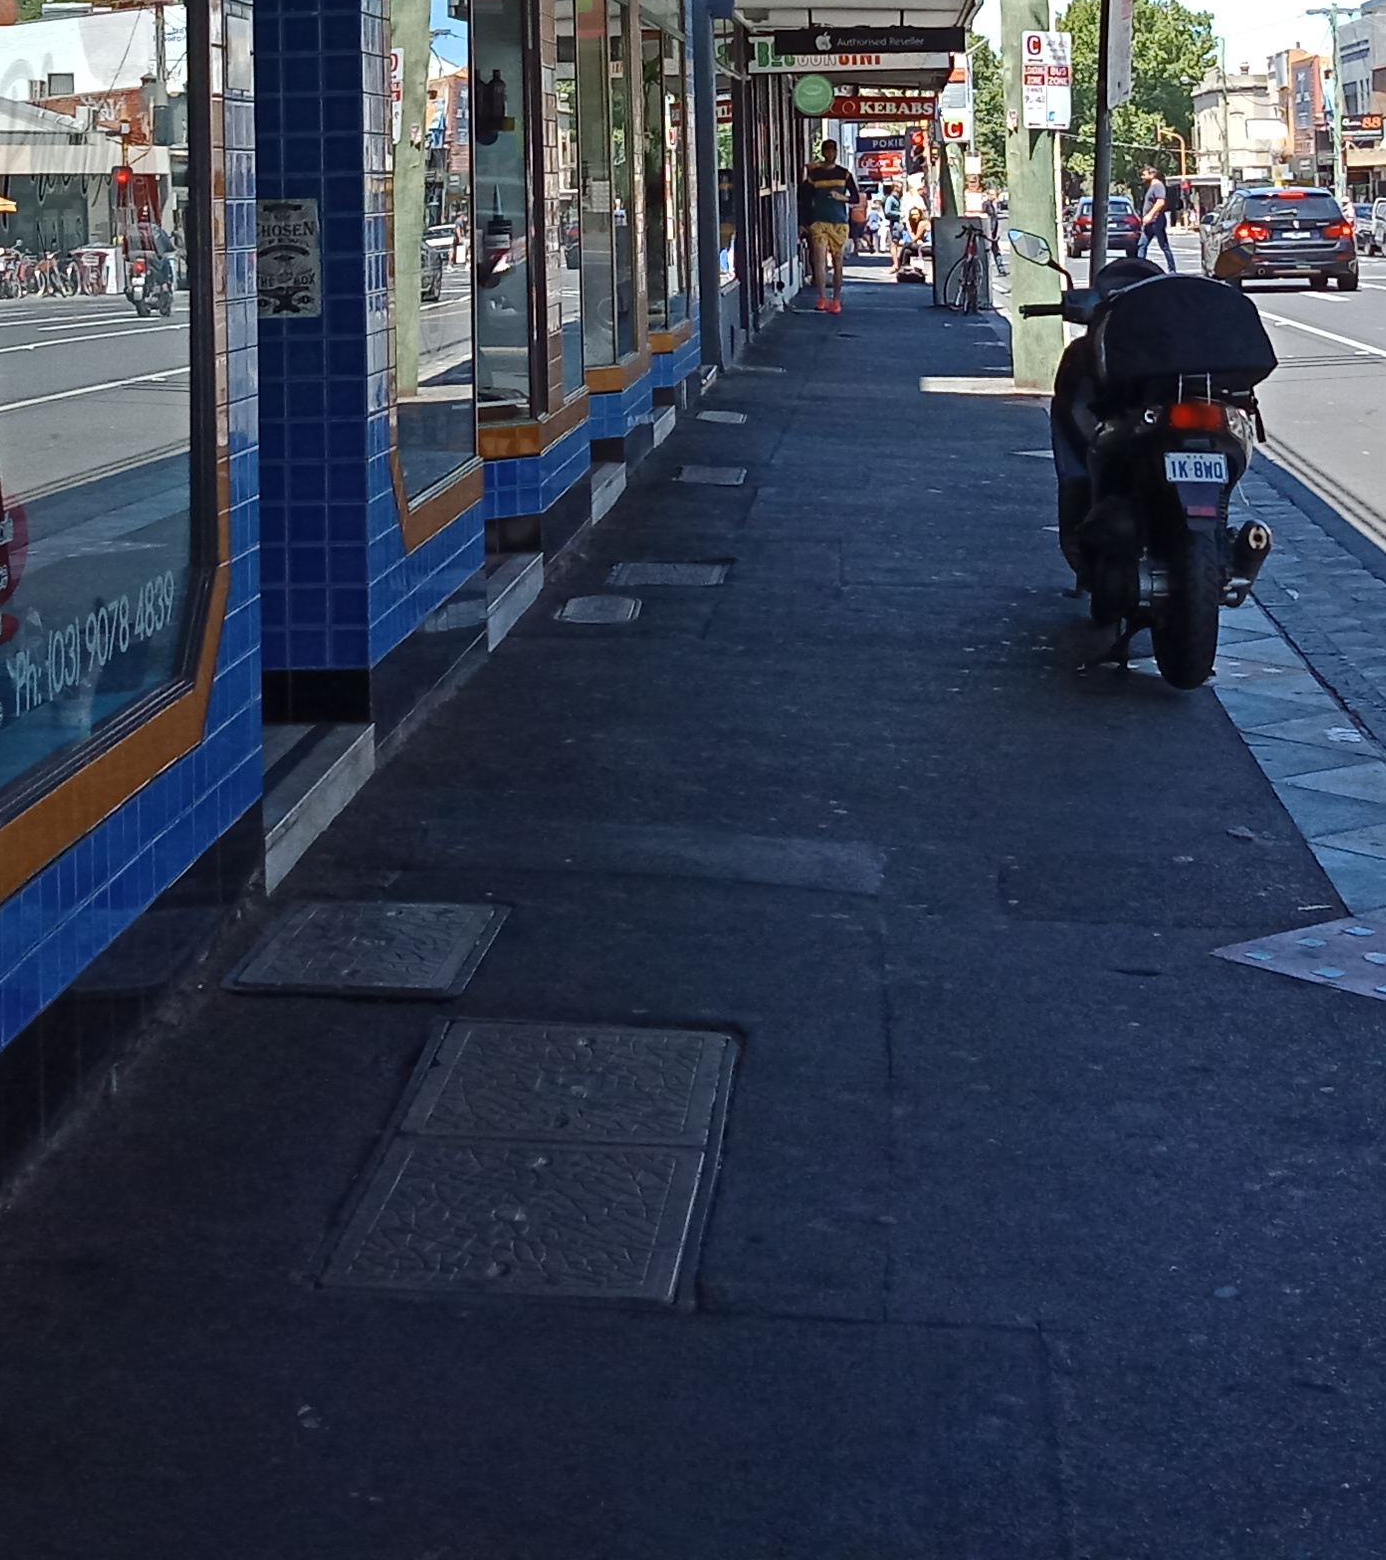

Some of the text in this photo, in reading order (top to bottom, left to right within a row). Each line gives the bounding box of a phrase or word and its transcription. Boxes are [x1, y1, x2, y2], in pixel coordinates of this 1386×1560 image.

[837, 36, 924, 47] Authorised Reseller
[859, 100, 934, 116] KEBABS
[7, 570, 175, 717] Ph: (03) 9078 4839
